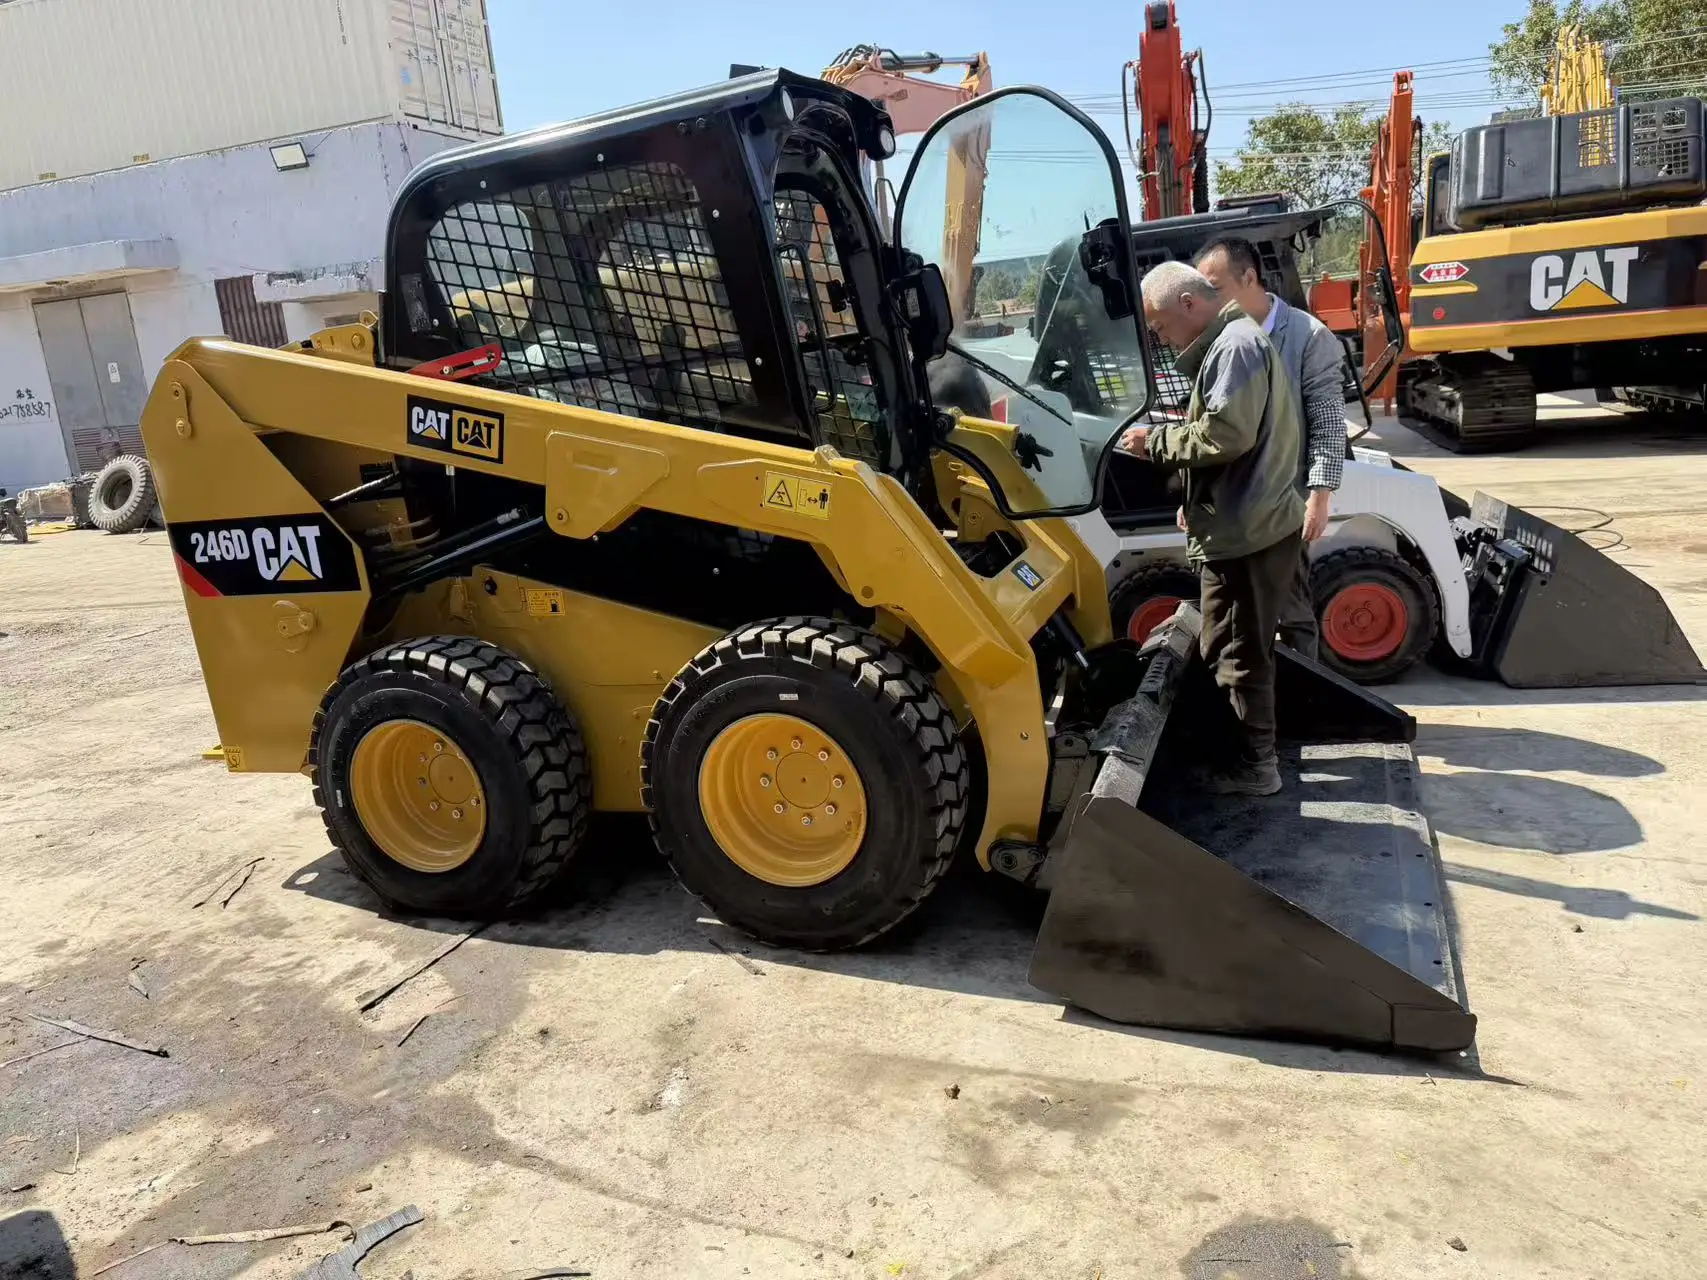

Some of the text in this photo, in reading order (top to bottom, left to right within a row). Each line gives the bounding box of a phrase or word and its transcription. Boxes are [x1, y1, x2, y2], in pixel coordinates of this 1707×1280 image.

[1530, 246, 1639, 311] CAT
[411, 406, 495, 450] CAT CAT
[190, 525, 323, 580] 246D CAT
